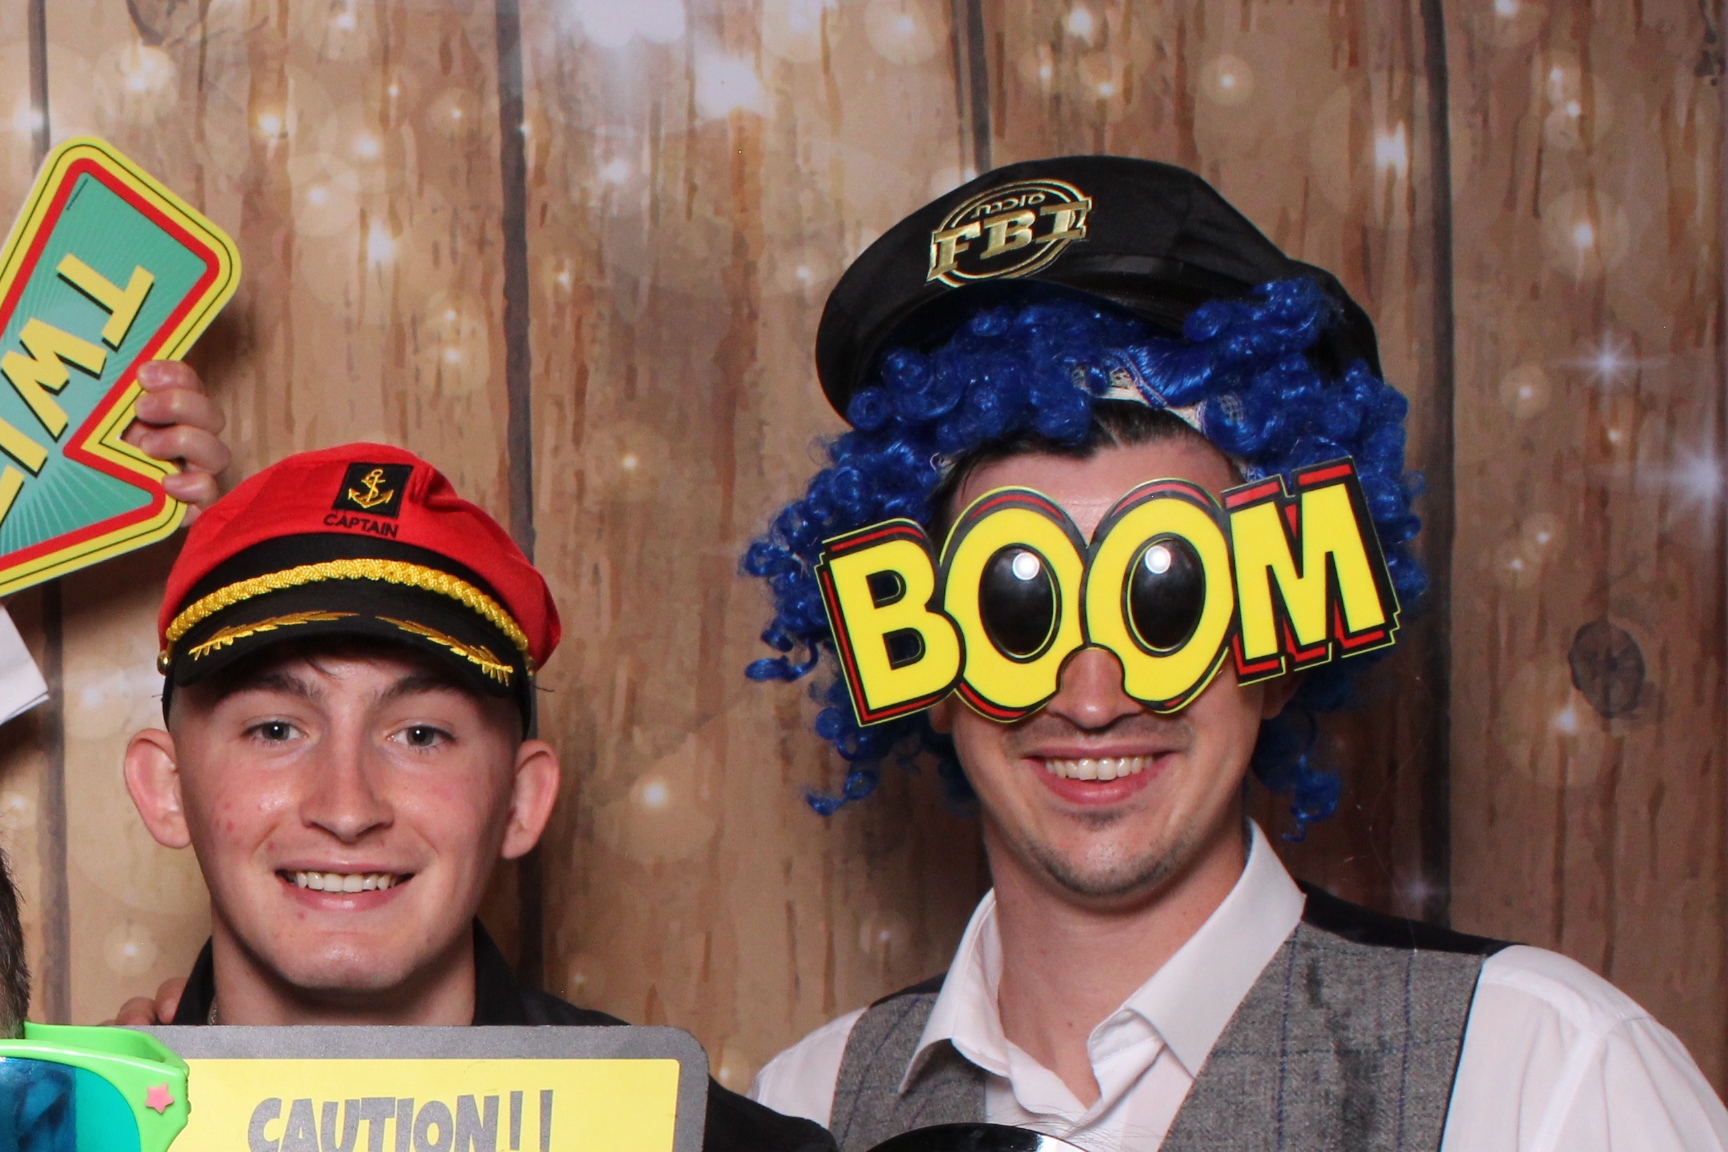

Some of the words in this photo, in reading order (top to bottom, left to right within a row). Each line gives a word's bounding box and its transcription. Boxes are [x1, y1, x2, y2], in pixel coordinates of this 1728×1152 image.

[926, 197, 1092, 282] FBI
[323, 513, 399, 539] CAPTAIN
[822, 472, 1394, 716] BOOM
